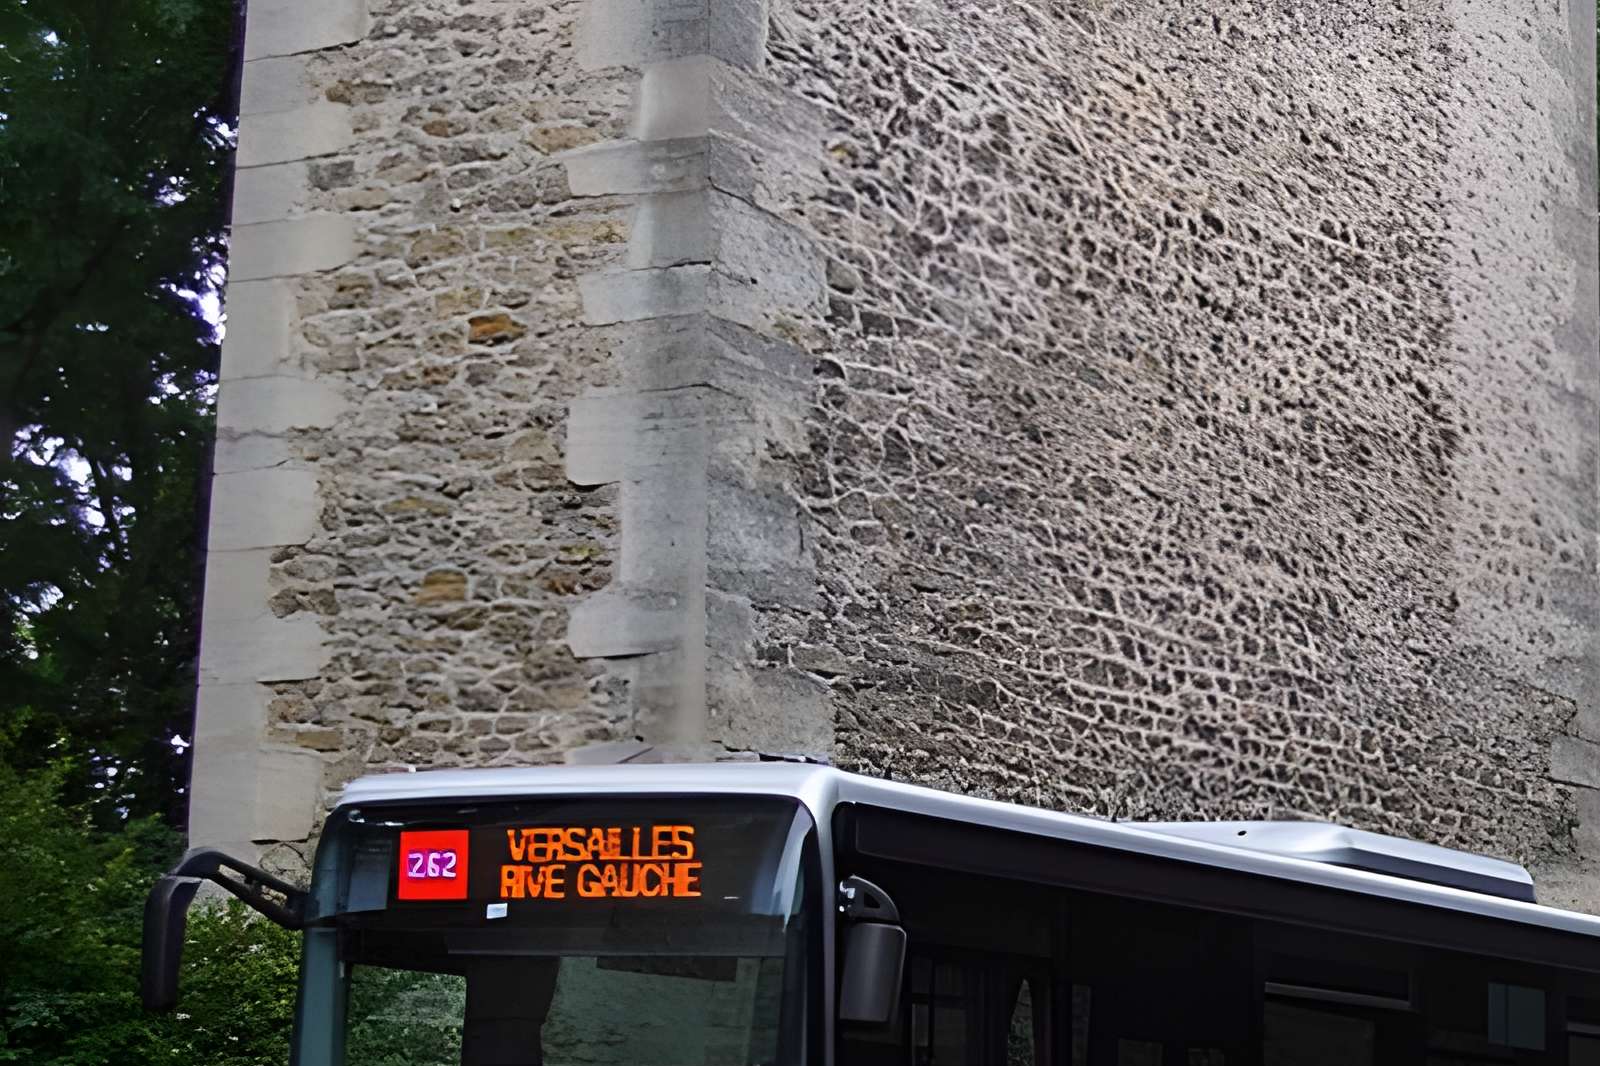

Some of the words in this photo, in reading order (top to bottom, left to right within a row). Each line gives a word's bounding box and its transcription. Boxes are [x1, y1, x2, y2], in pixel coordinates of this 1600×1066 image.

[507, 825, 696, 862] VERSAILLES
[407, 852, 457, 878] 262
[500, 864, 567, 899] RIVE
[576, 862, 703, 898] GAUCHE
